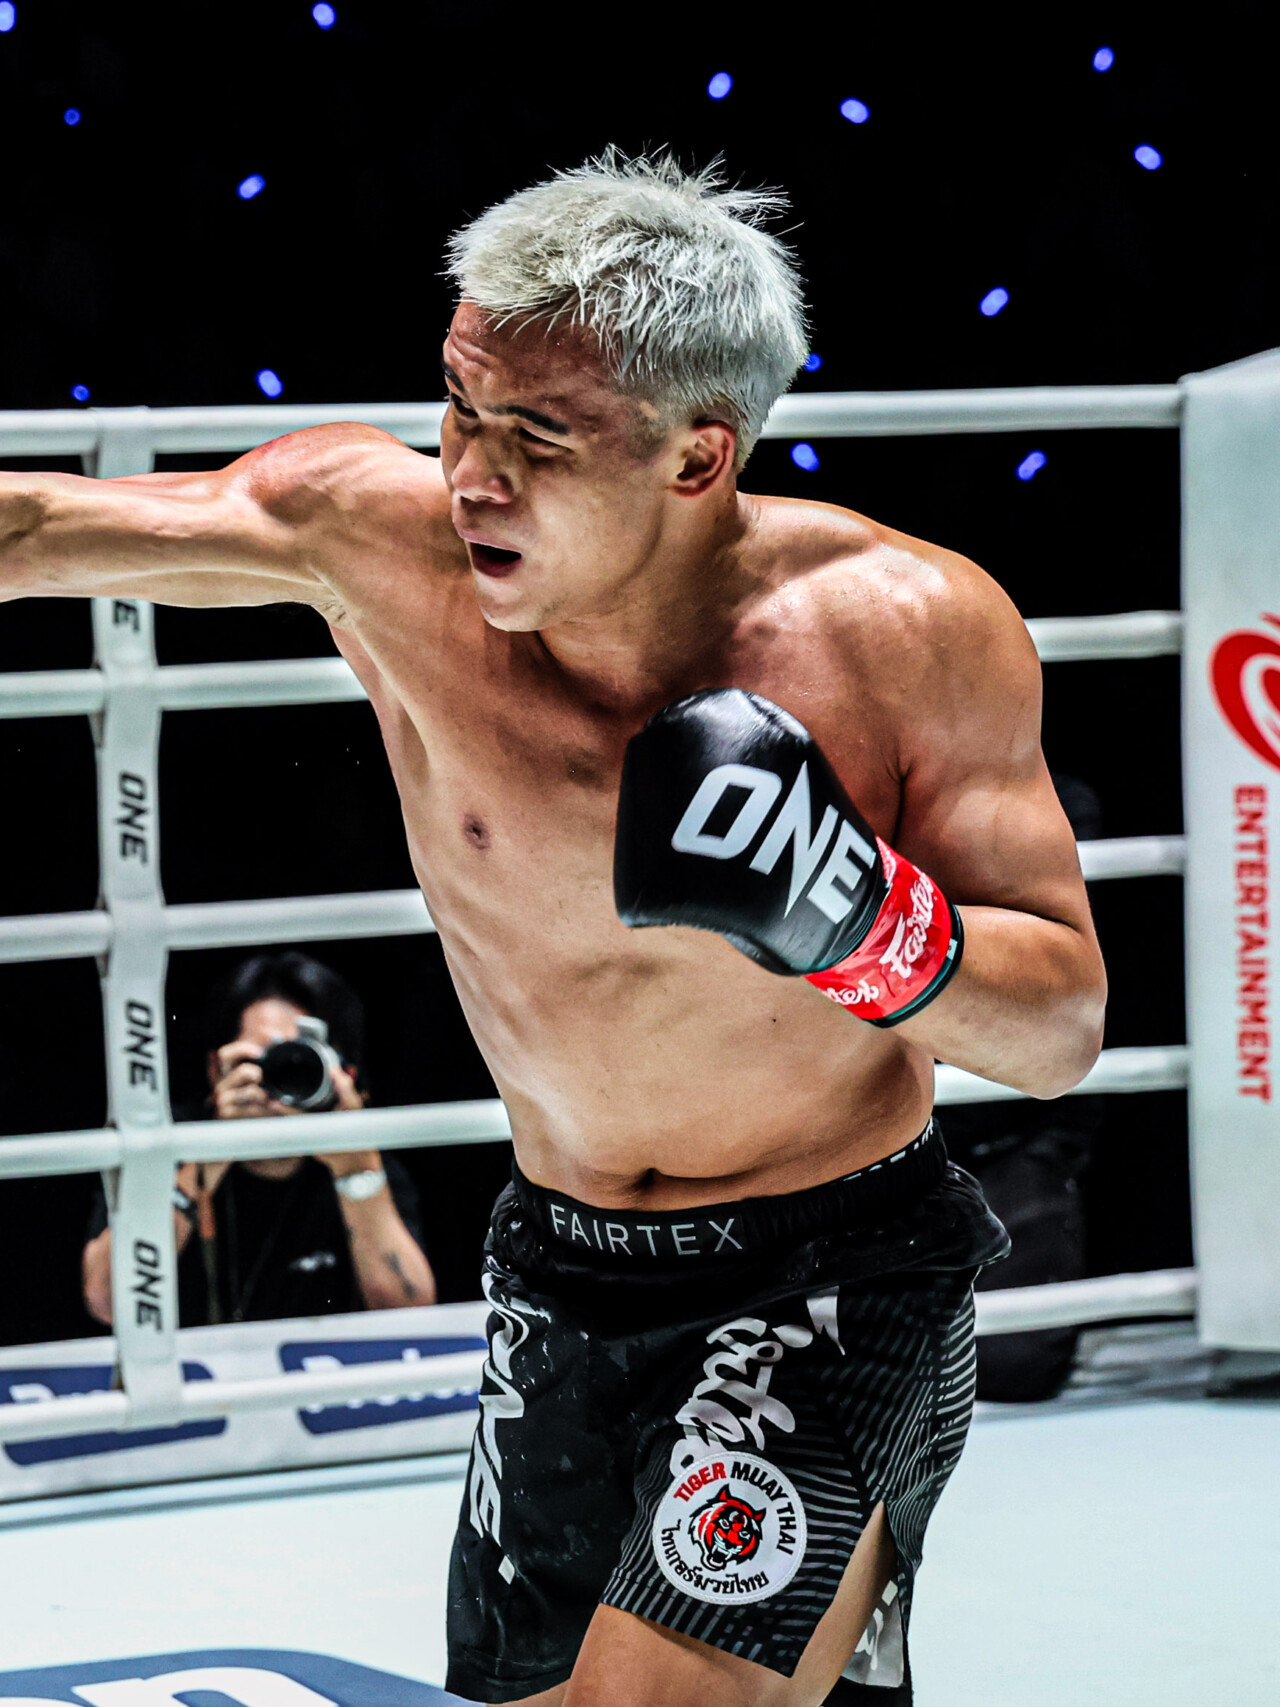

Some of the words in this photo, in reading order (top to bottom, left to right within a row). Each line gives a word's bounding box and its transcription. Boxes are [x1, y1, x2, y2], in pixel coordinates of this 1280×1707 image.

[116, 772, 149, 865] ONE
[671, 760, 877, 925] ONE
[1233, 784, 1272, 1104] ENTERTAINMENT
[123, 998, 158, 1094] ONE
[550, 1203, 743, 1256] FAIRTEX
[130, 1239, 164, 1334] ONE
[674, 1462, 727, 1502] TIGER
[730, 1461, 789, 1502] MUAY
[776, 1502, 797, 1556] THAI
